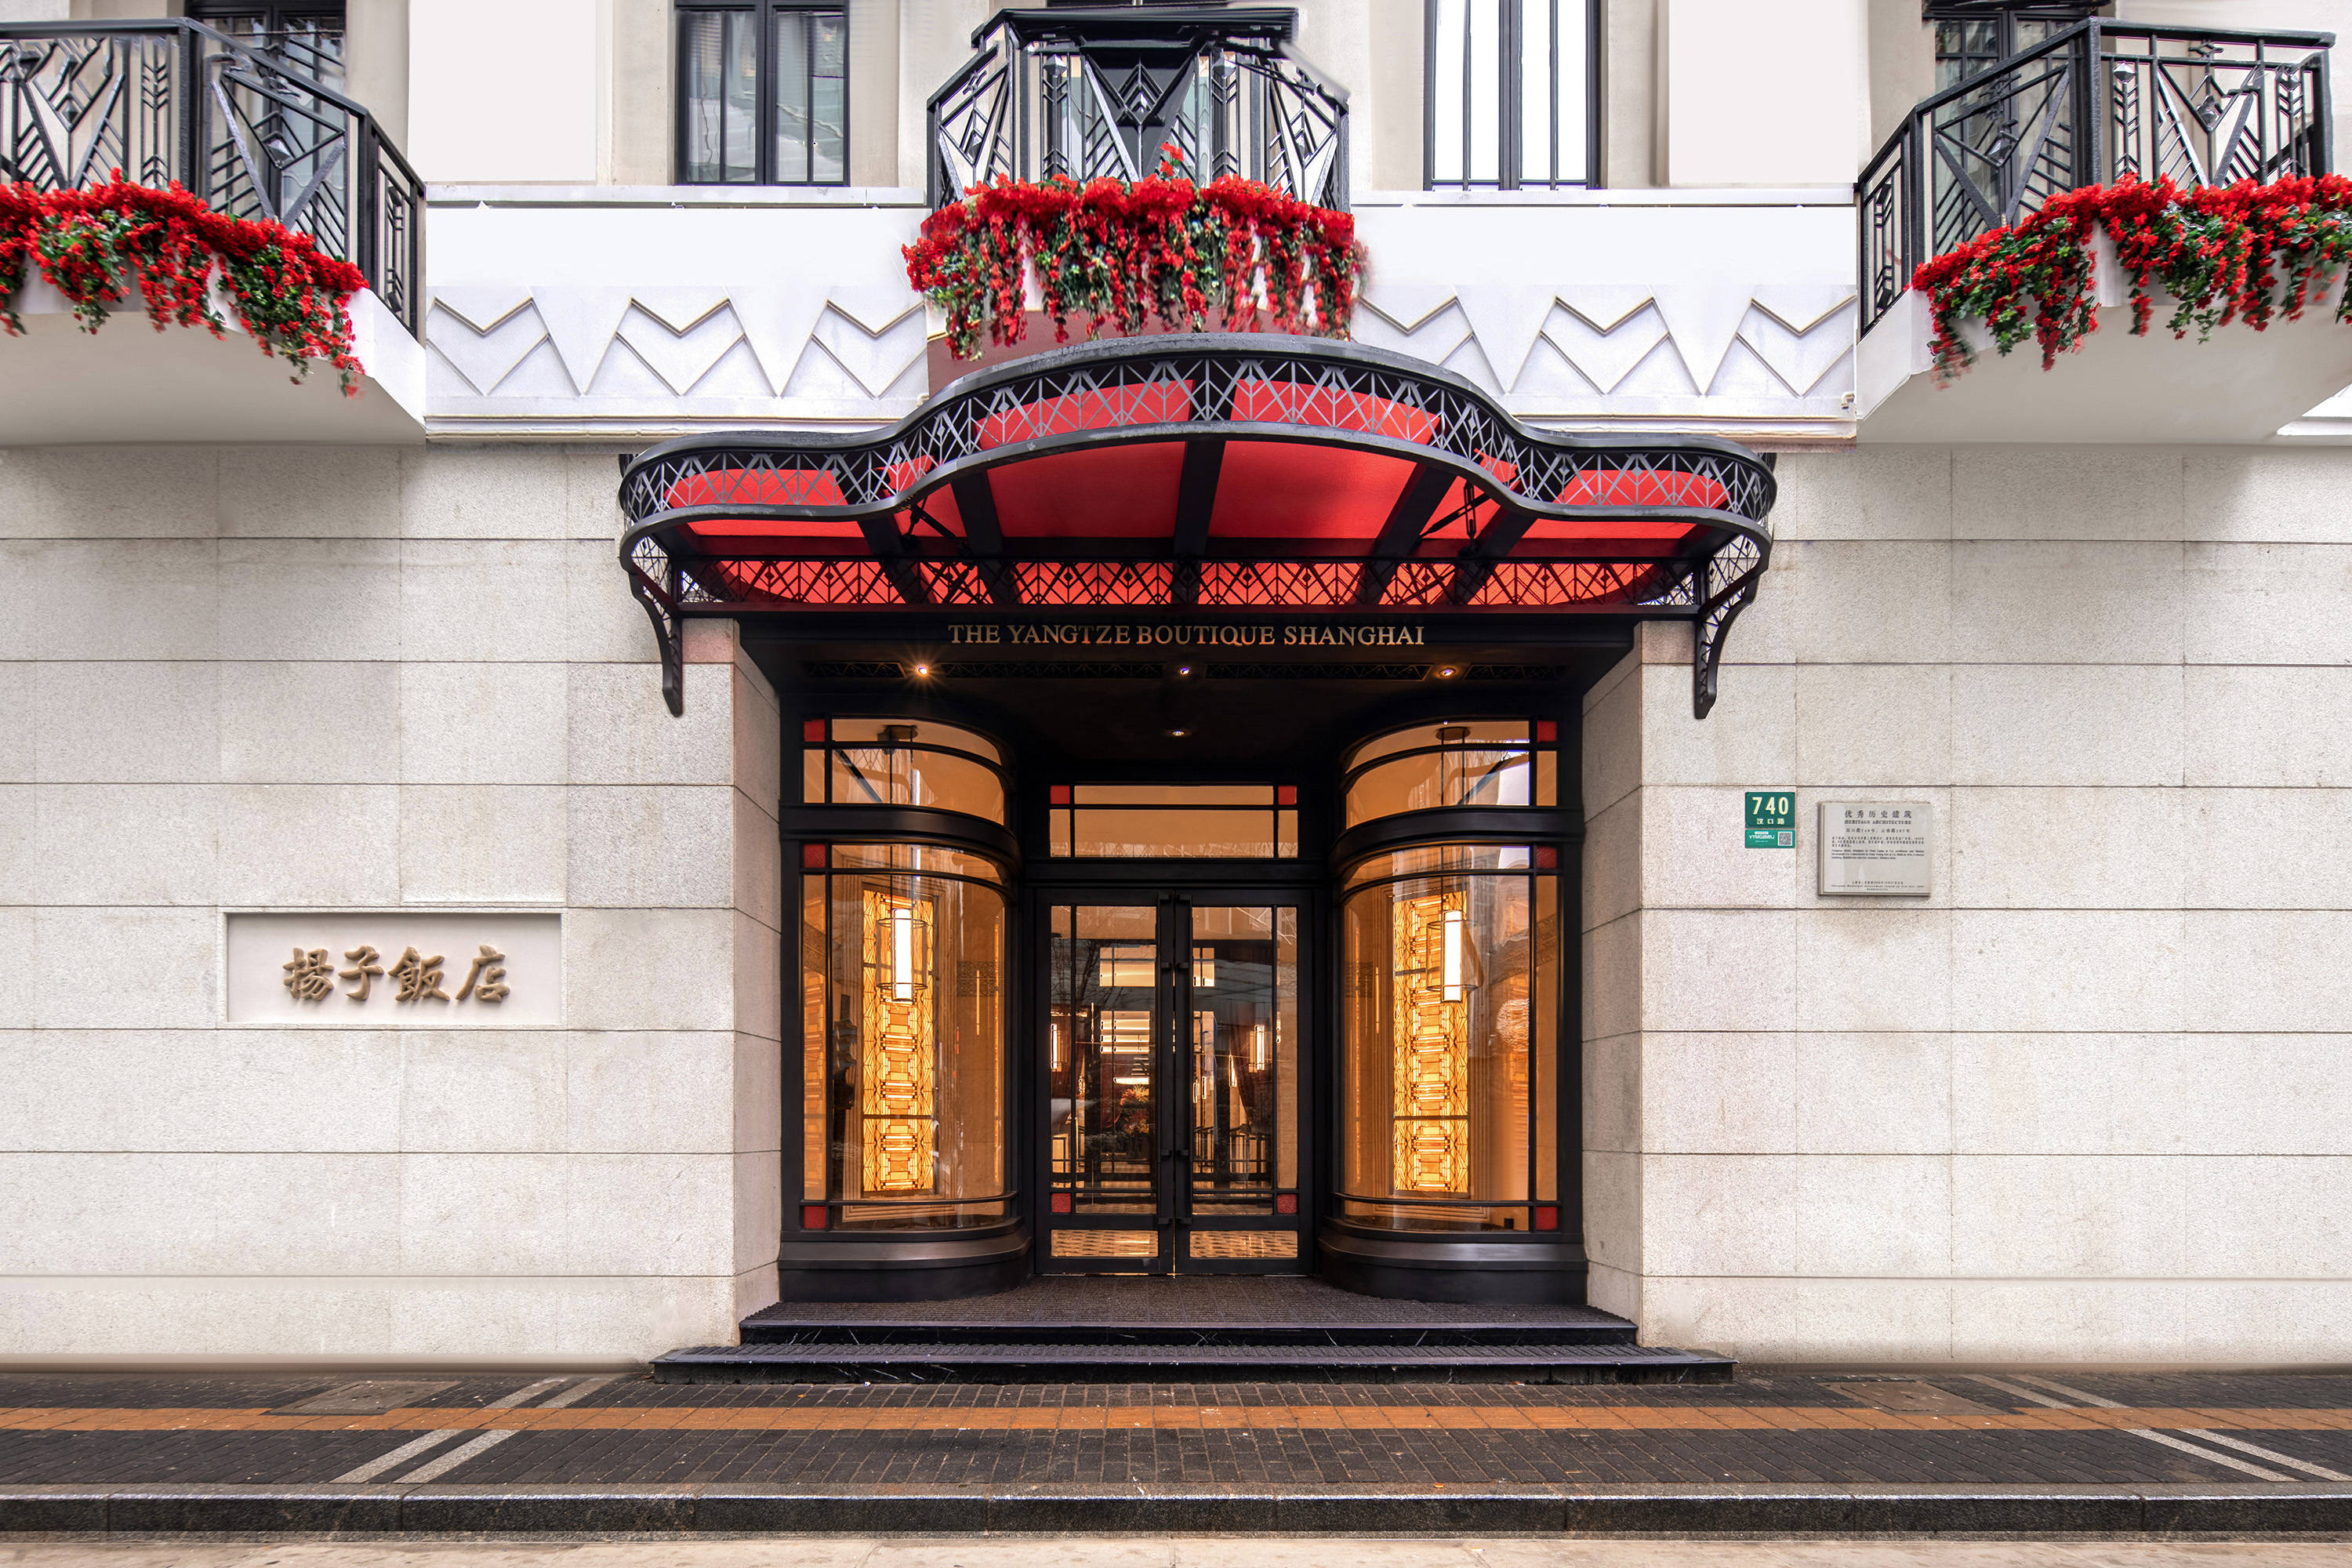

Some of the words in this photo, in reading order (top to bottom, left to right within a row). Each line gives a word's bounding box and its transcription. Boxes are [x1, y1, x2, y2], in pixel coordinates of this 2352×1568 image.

[950, 624, 1000, 644] THE
[1007, 624, 1131, 644] YANGTZE
[1136, 624, 1276, 648] BOUTIQUE
[1283, 624, 1425, 647] SHANGHAI
[1751, 797, 1789, 815] 740
[1844, 809, 1912, 818] 优秀历史建筑
[282, 944, 511, 1003] 揚子飯店
